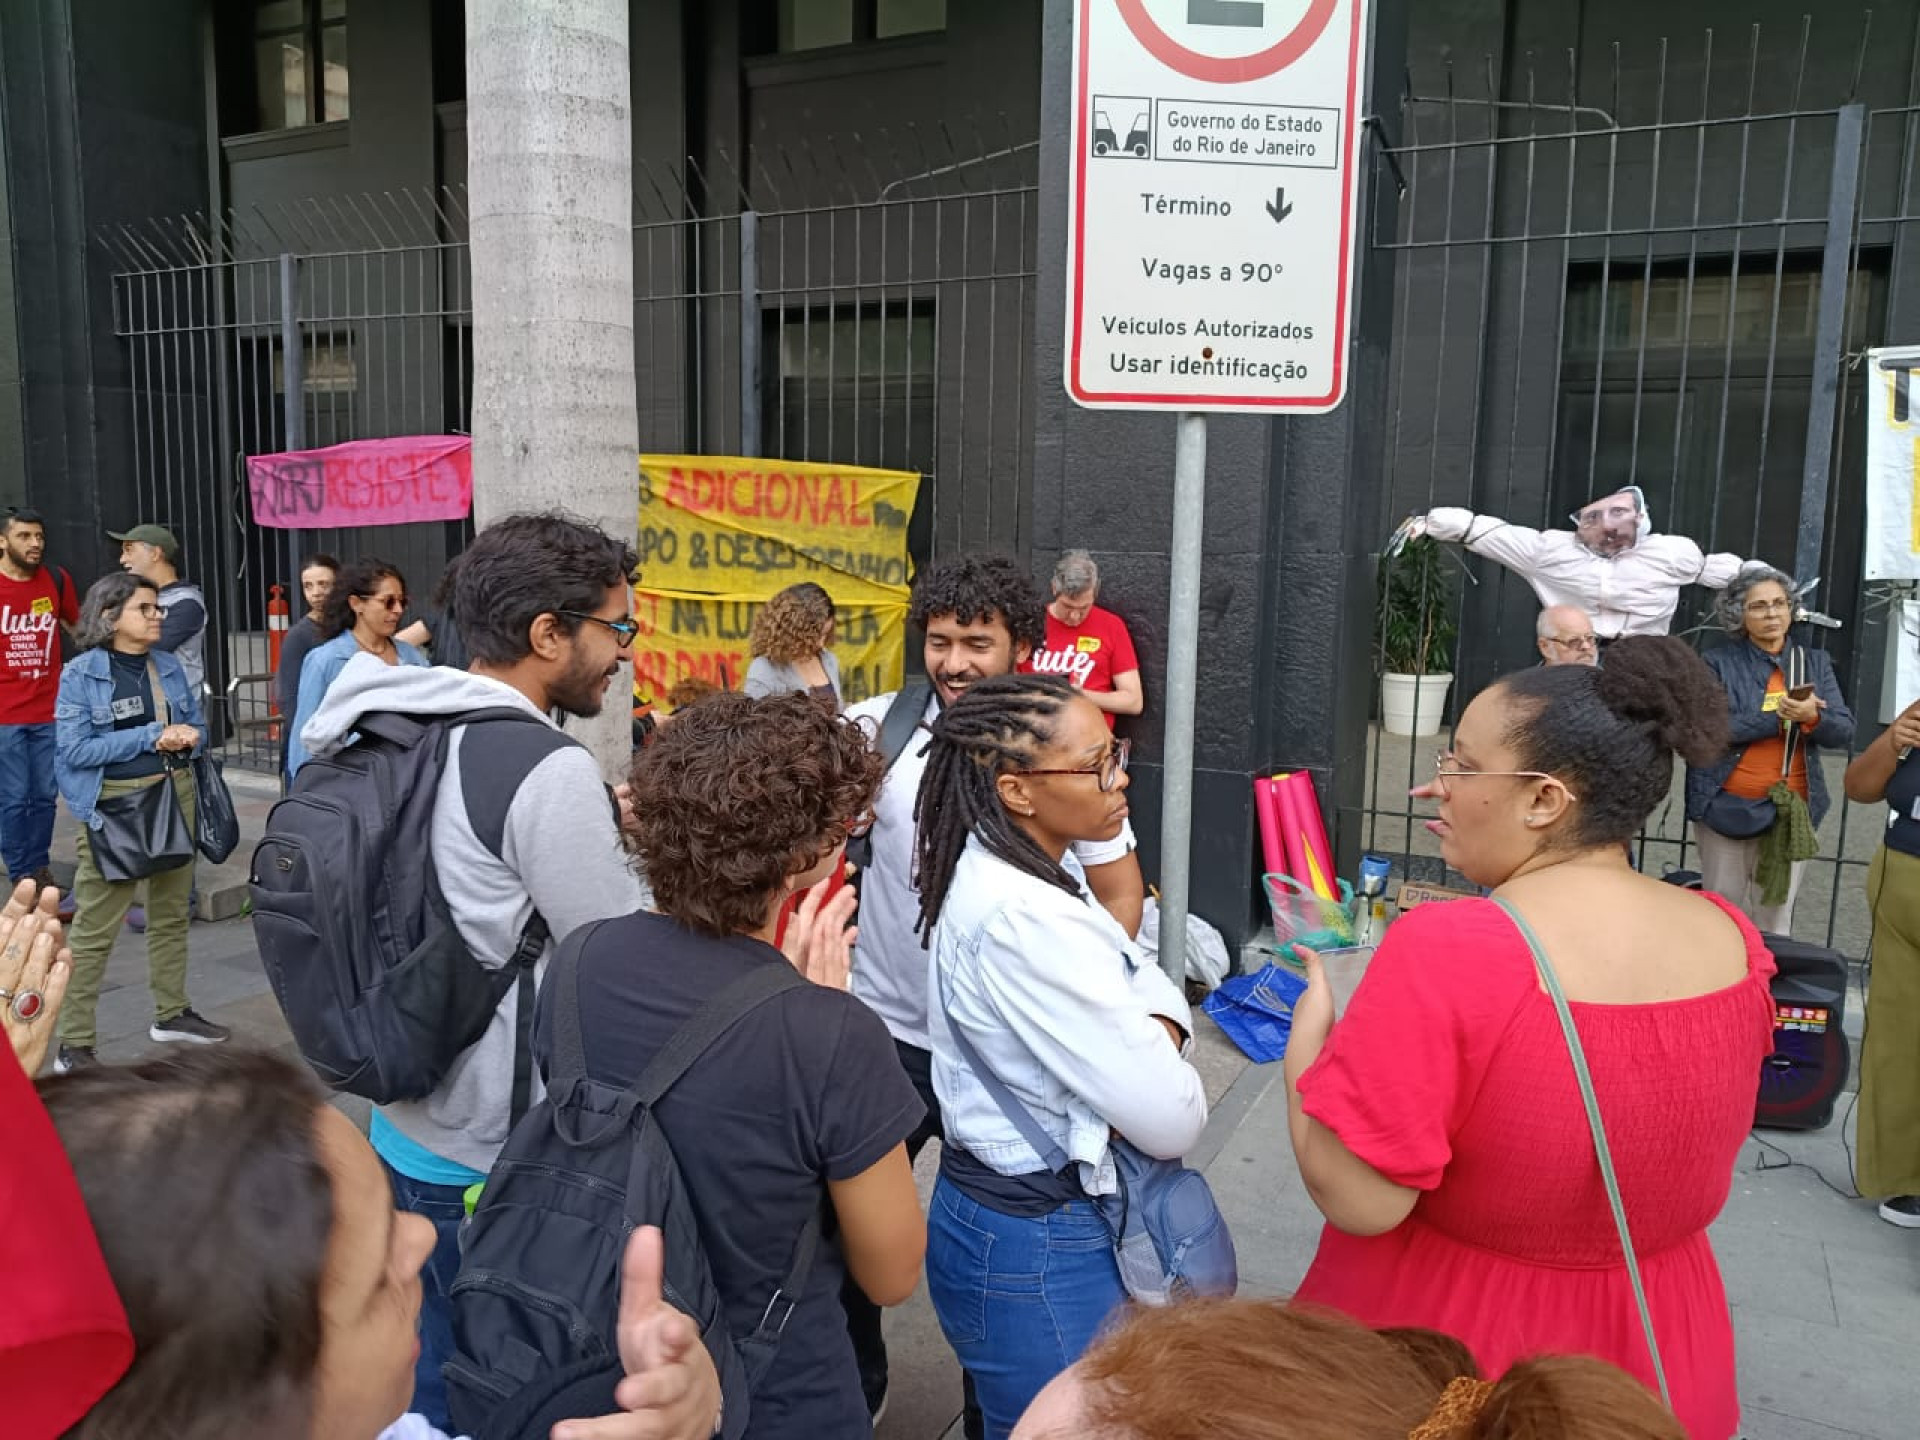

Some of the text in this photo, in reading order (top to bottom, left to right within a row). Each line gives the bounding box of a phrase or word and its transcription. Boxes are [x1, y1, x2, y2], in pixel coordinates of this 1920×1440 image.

[1167, 110, 1323, 133] Governo do Estado
[1172, 136, 1316, 157] do Rio de Janeiro
[1141, 193, 1232, 217] Término
[1142, 257, 1211, 285] Vagas
[1220, 266, 1231, 281] a
[1193, 319, 1313, 340] Autorizados
[1110, 353, 1308, 383] Usar identificação
[664, 467, 871, 526] ADICIONAL
[689, 532, 709, 569] &
[671, 598, 709, 638] NA
